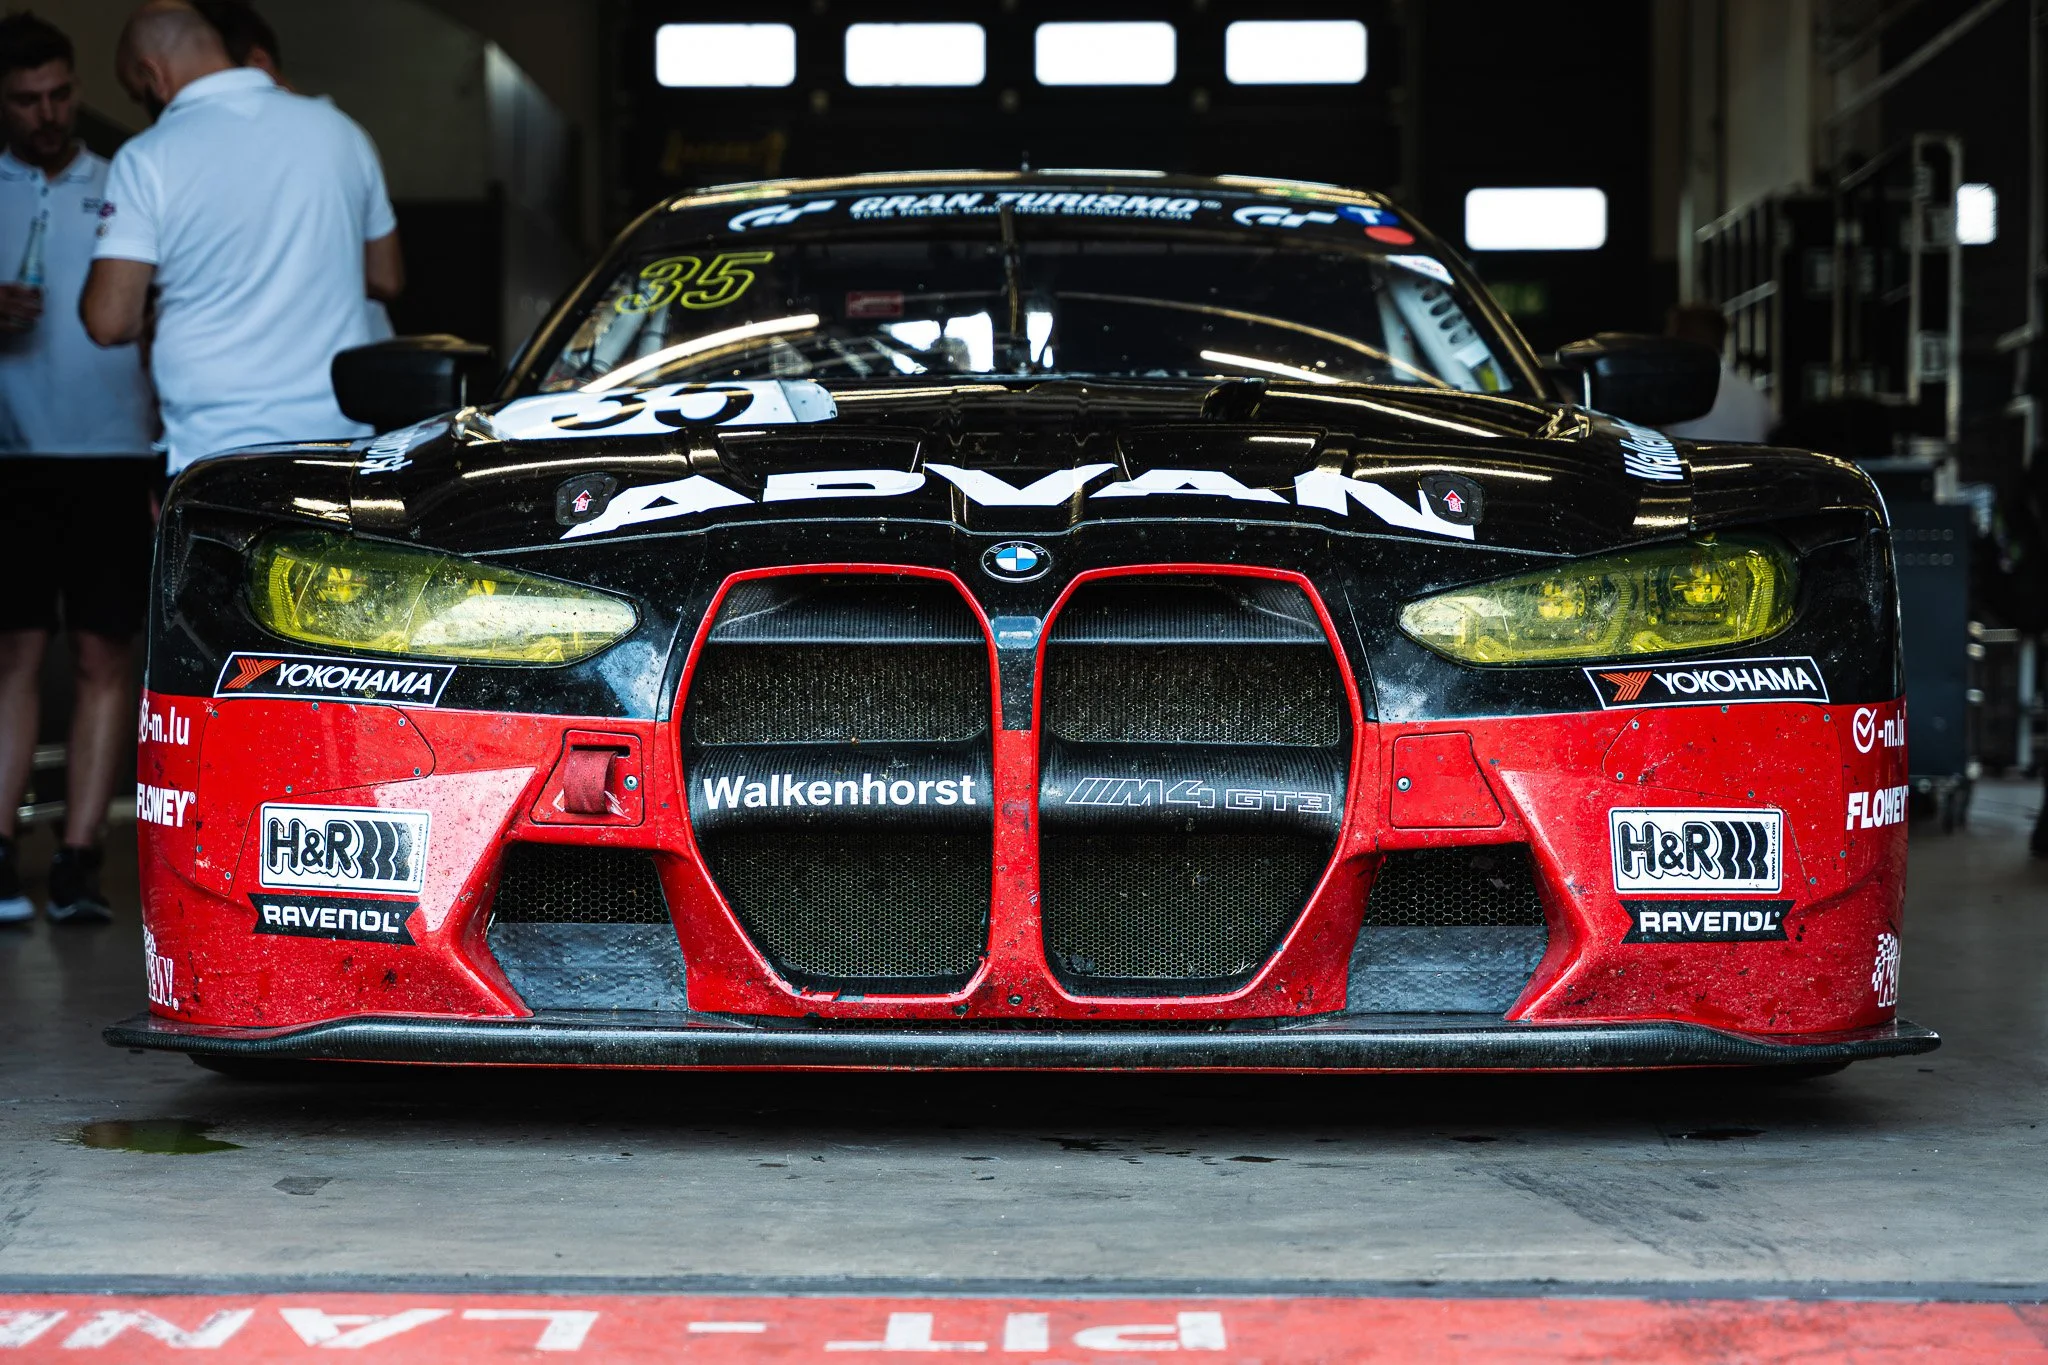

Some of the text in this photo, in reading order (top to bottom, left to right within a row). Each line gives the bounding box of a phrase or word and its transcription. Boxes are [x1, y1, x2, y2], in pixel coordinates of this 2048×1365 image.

[850, 193, 1200, 213] GRAN TURISMO
[615, 251, 774, 314] 35
[559, 463, 1475, 541] ADVAN
[276, 663, 434, 695] YOKOHAMA
[1654, 666, 1818, 695] YOKOHAMA
[703, 773, 977, 810] Walkenhorst
[1226, 788, 1332, 813] GT3
[268, 818, 359, 878] H&R
[1619, 821, 1720, 879] H&R
[1769, 821, 1777, 881] www.h-r.com
[262, 904, 400, 934] RAVENOL
[1639, 911, 1778, 933] RAVENOL
[825, 1311, 1227, 1352] PIT
